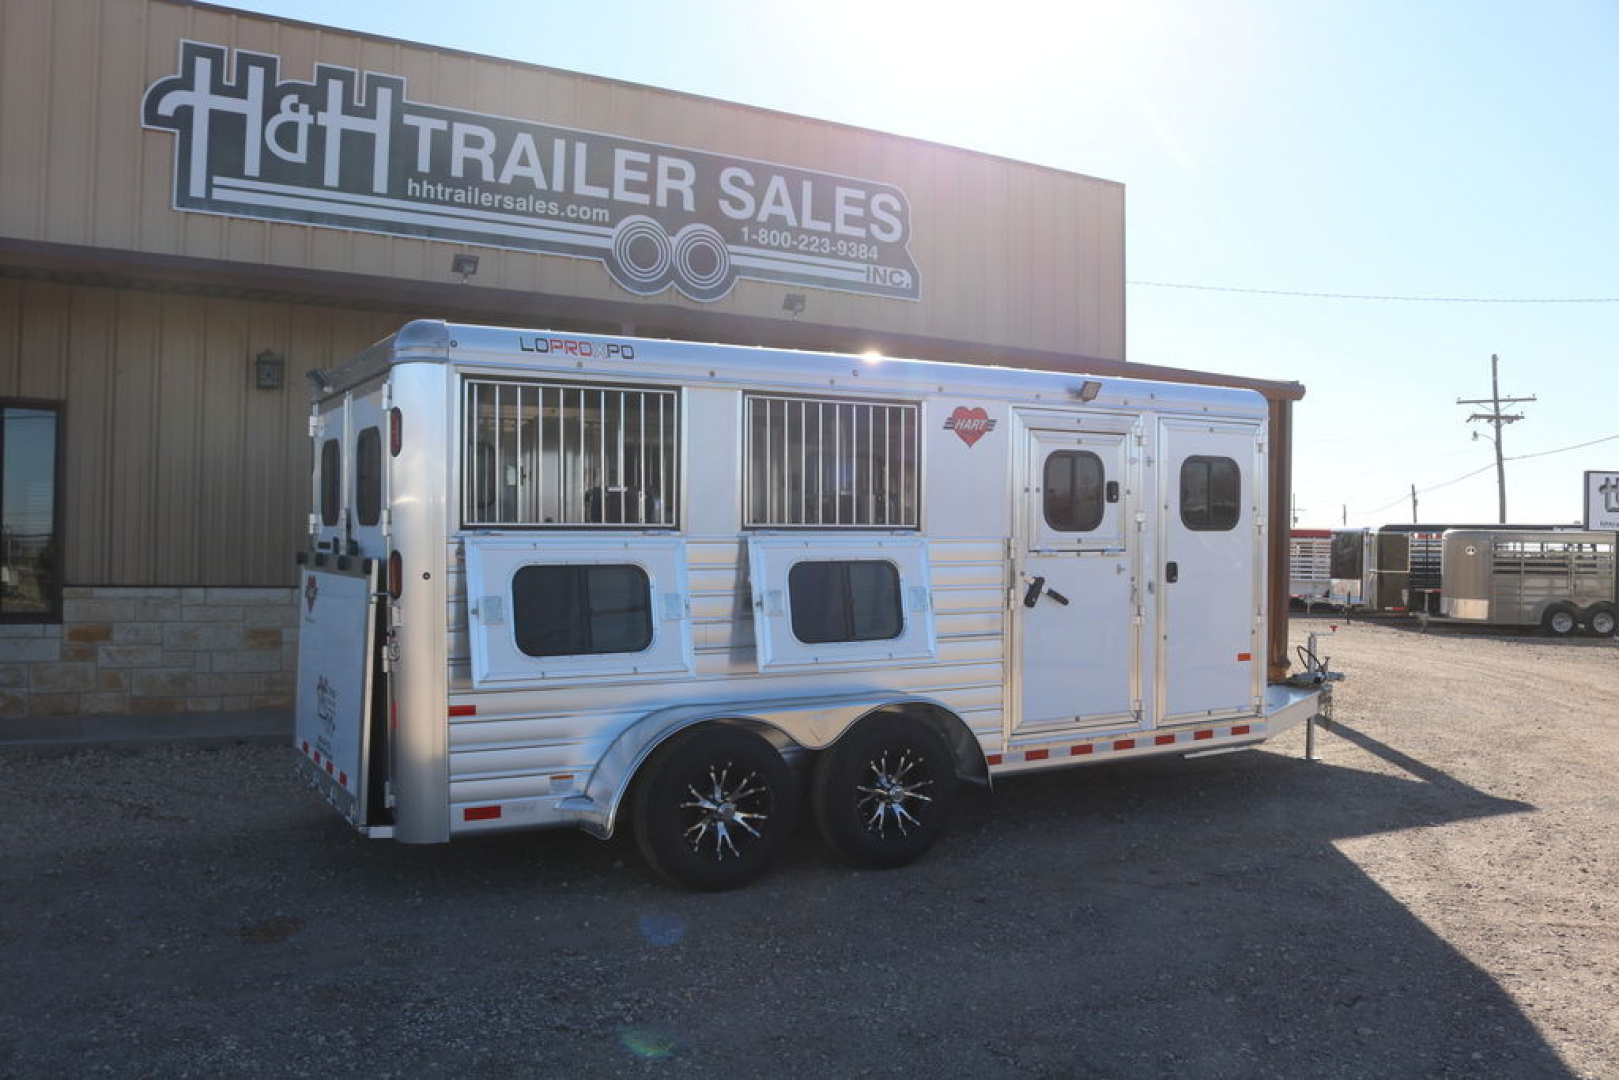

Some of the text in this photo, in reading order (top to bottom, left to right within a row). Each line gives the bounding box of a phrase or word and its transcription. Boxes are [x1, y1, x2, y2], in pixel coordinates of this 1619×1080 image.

[156, 55, 902, 243] H&H TRAILER SALES
[407, 178, 610, 223] hhtrailersales.com
[740, 225, 879, 261] 1-800-223-9384
[953, 417, 988, 432] HART
